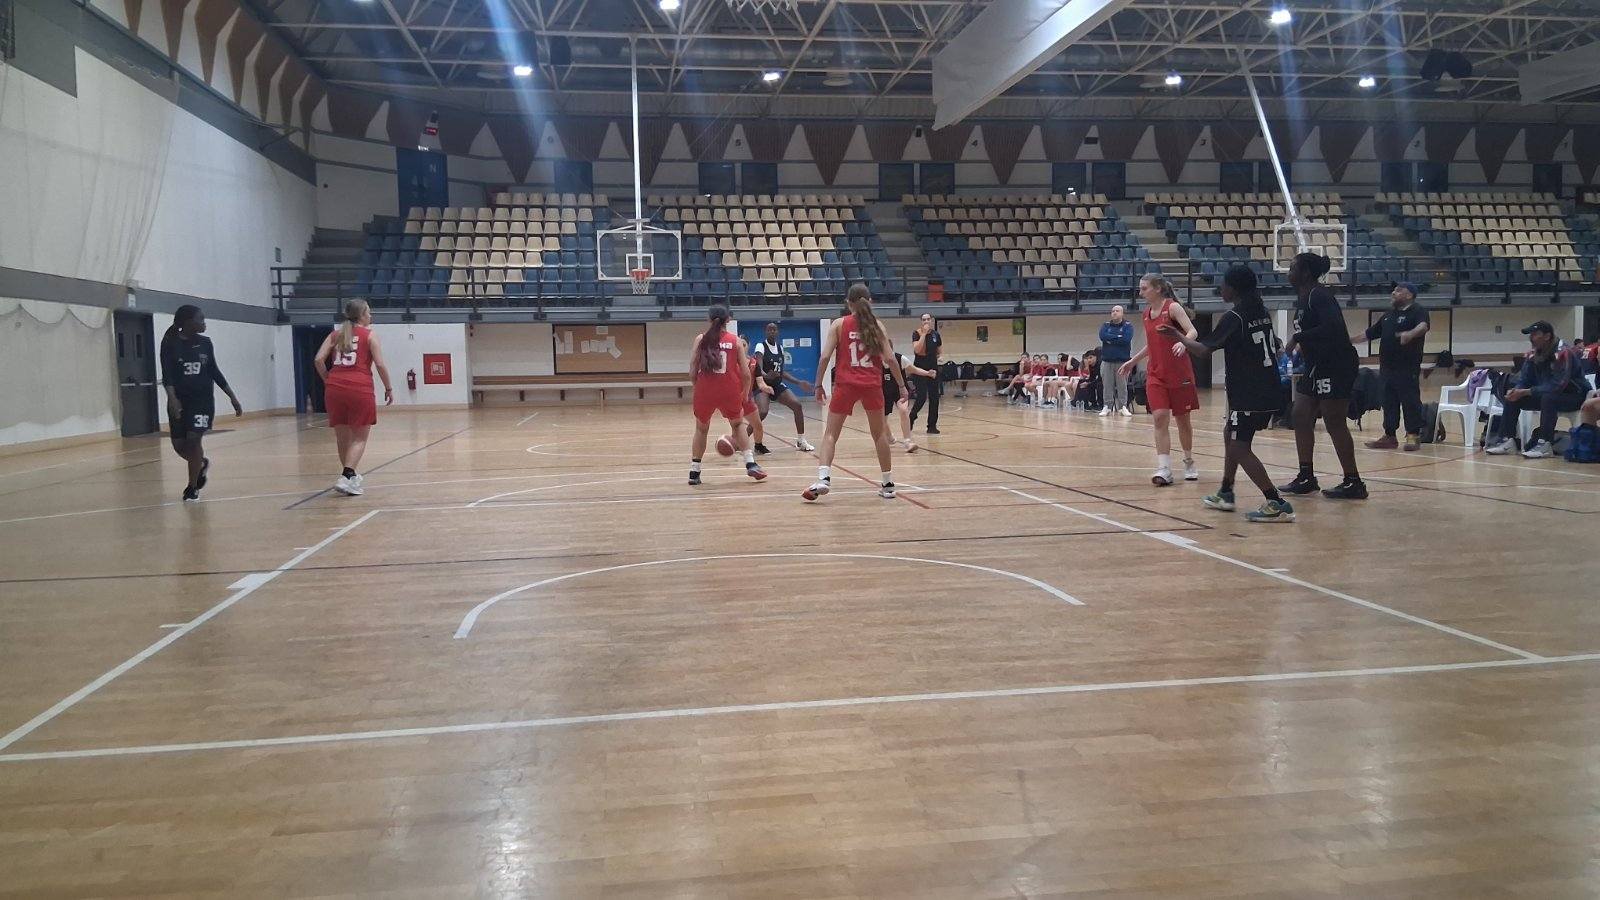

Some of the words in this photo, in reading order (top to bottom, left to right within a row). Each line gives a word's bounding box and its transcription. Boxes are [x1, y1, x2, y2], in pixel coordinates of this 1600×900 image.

[848, 341, 873, 367] 12
[183, 362, 201, 375] 39
[1316, 378, 1331, 394] 35
